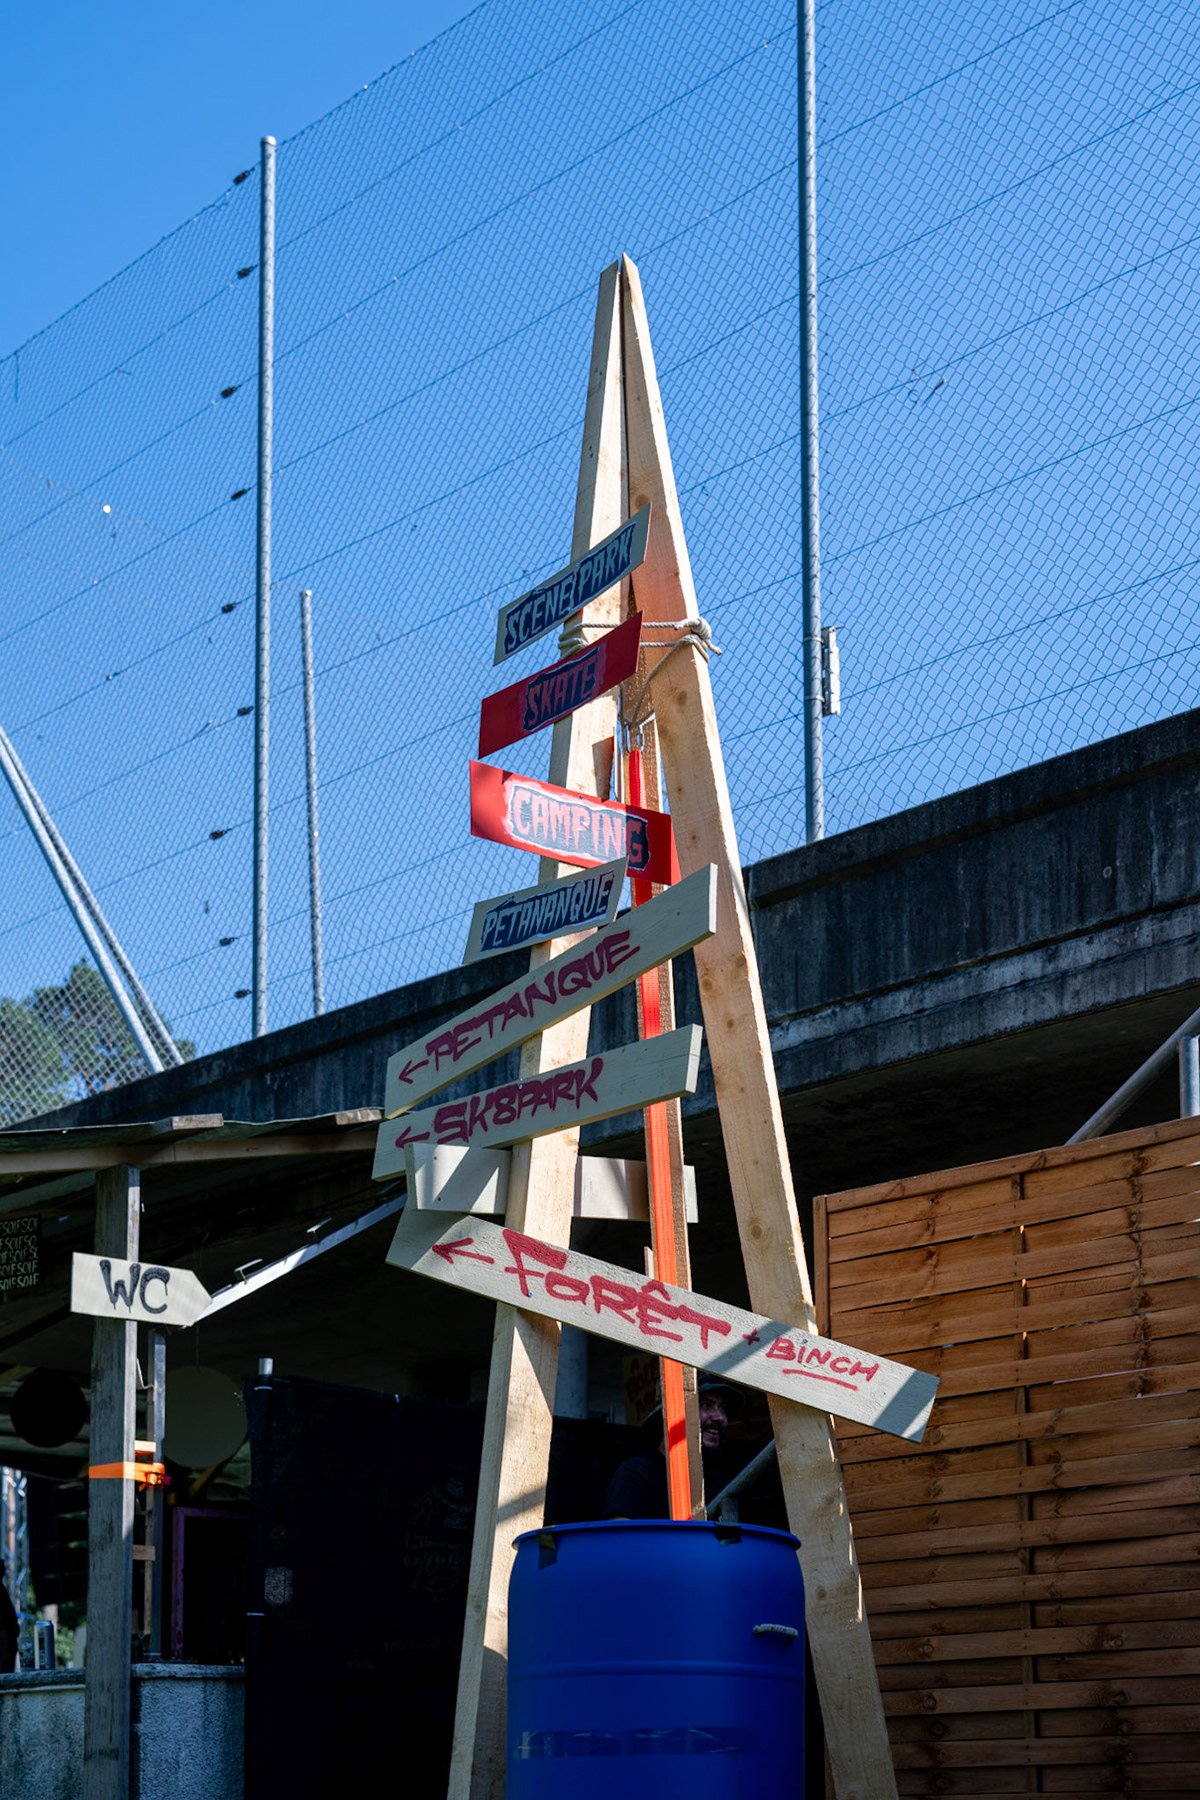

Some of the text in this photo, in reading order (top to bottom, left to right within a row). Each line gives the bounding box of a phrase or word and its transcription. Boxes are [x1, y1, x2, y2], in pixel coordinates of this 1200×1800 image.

[507, 525, 633, 650] SCENE PARK
[526, 657, 597, 728] SKATE
[513, 789, 646, 864] CAMPING
[425, 930, 640, 1072] PETANQUE
[433, 1057, 603, 1145] SK8PARK
[99, 1259, 170, 1314] WC
[502, 1228, 732, 1349] FORÊT
[766, 1337, 879, 1382] BINCH
